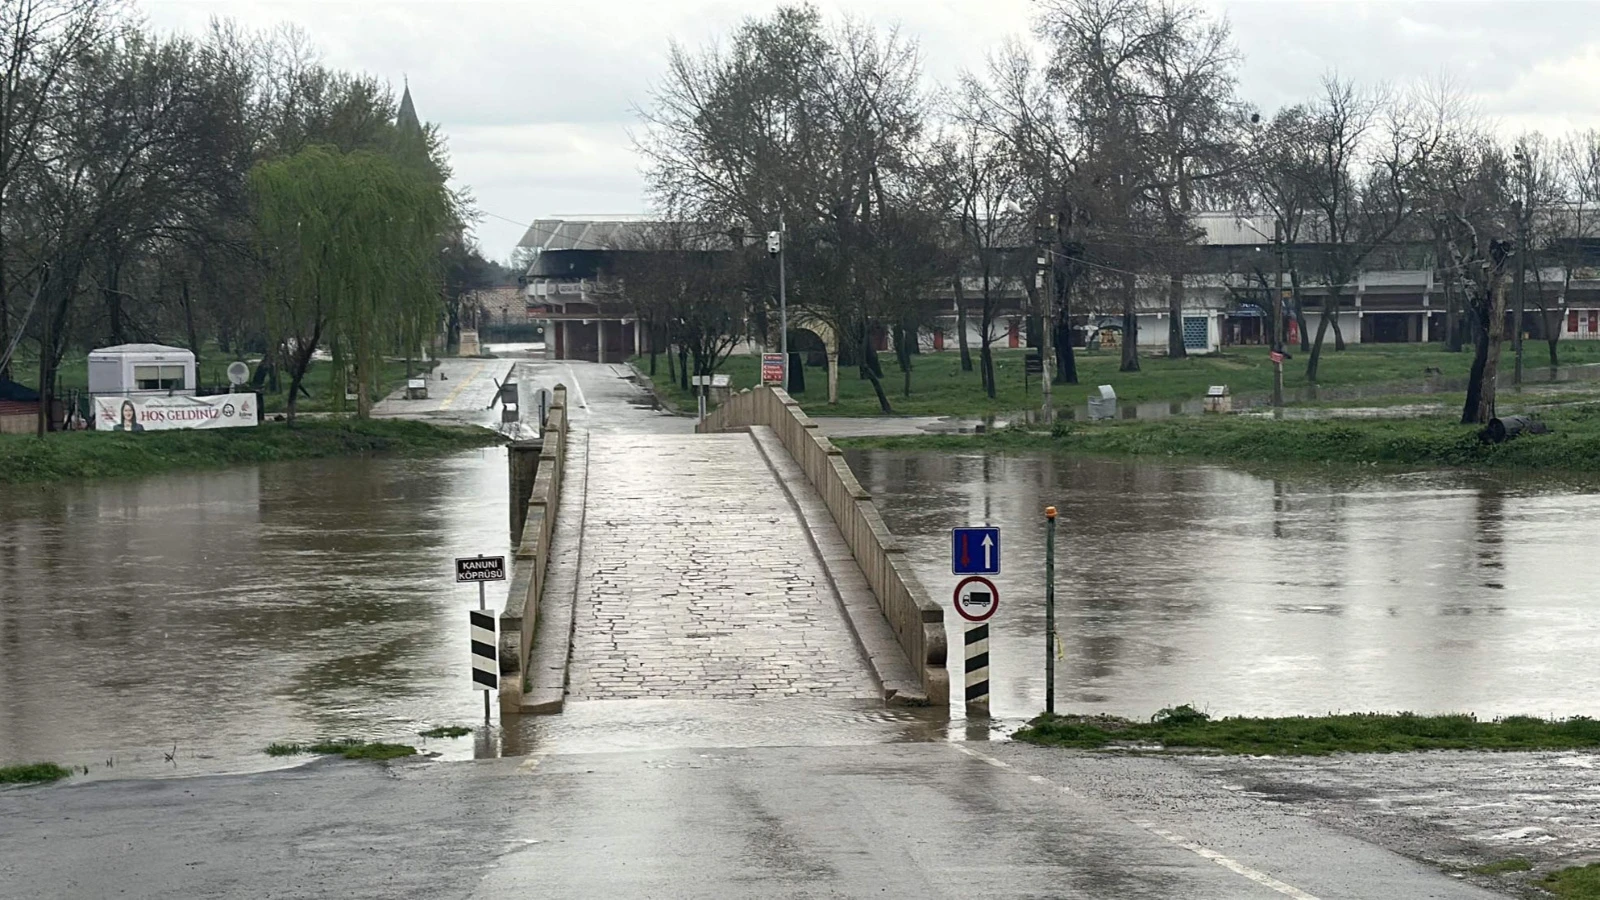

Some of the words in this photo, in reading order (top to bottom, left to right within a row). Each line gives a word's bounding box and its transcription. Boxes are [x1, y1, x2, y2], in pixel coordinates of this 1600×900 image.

[141, 410, 165, 422] HOŞ
[166, 407, 220, 421] GELDİNİZ
[458, 569, 503, 579] KÖPRÜSÜ
